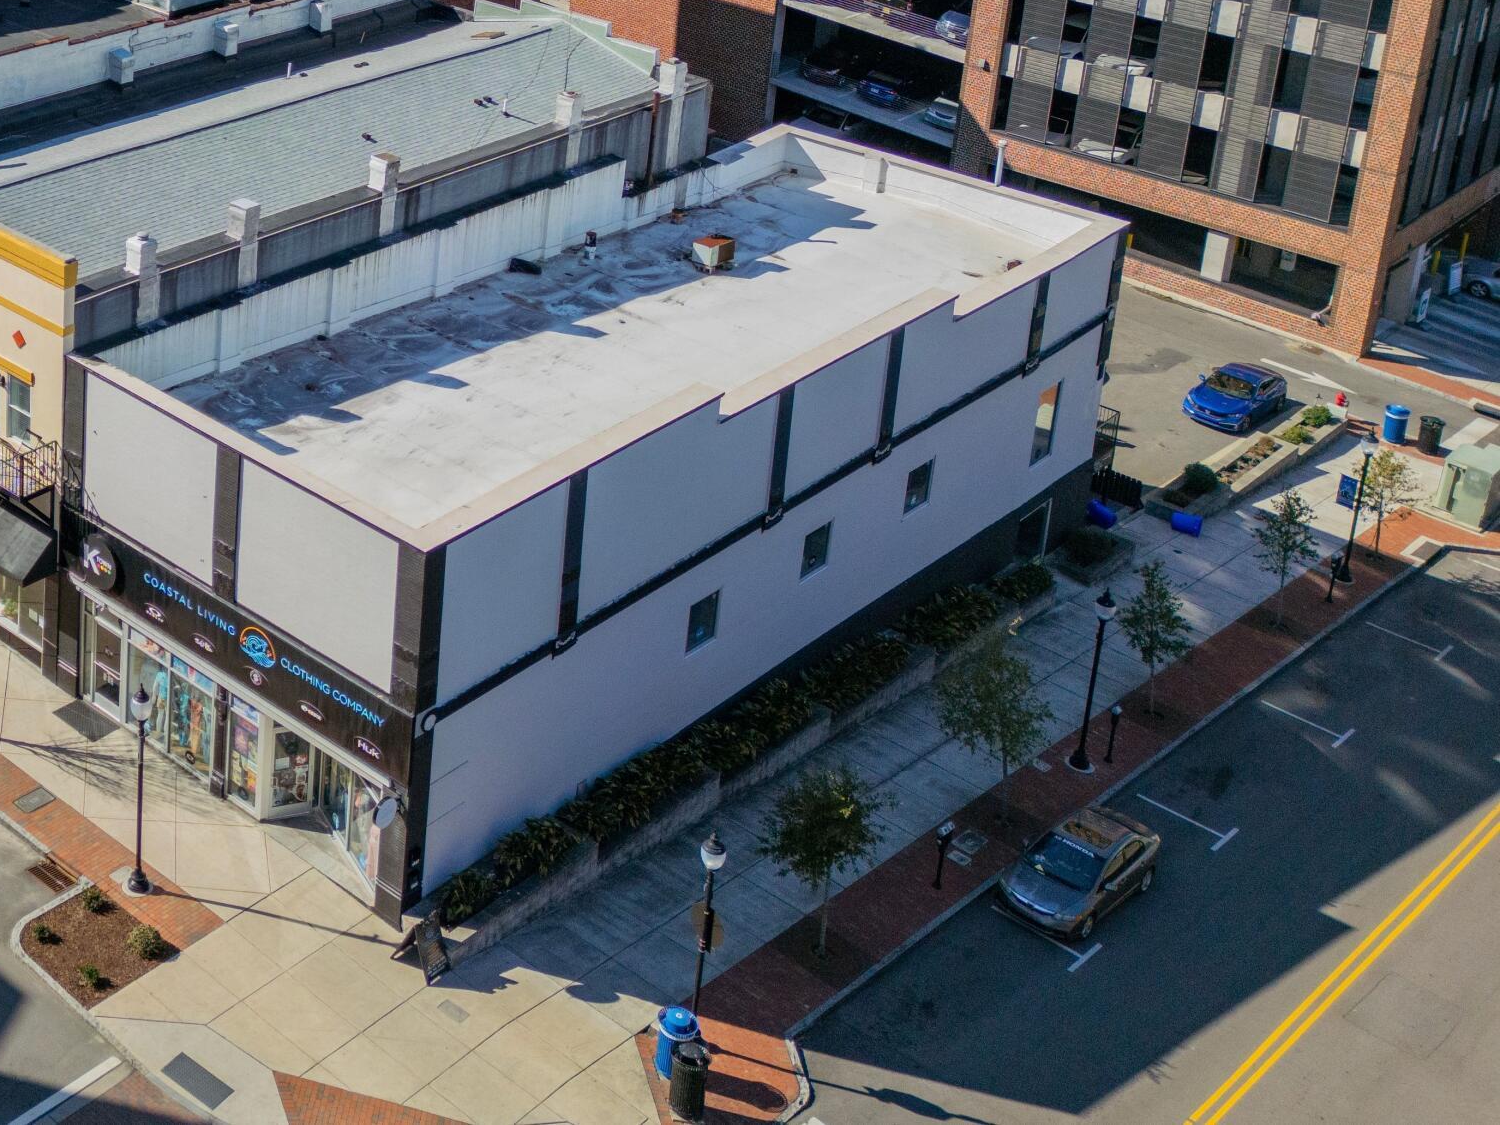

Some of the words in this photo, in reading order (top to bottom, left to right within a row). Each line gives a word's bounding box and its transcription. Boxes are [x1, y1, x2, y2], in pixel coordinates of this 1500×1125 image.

[84, 543, 100, 575] K
[143, 573, 194, 610] COASTAL
[197, 605, 237, 636] LIVING
[280, 657, 331, 695] CLOTHING
[332, 689, 385, 728] COMPANY
